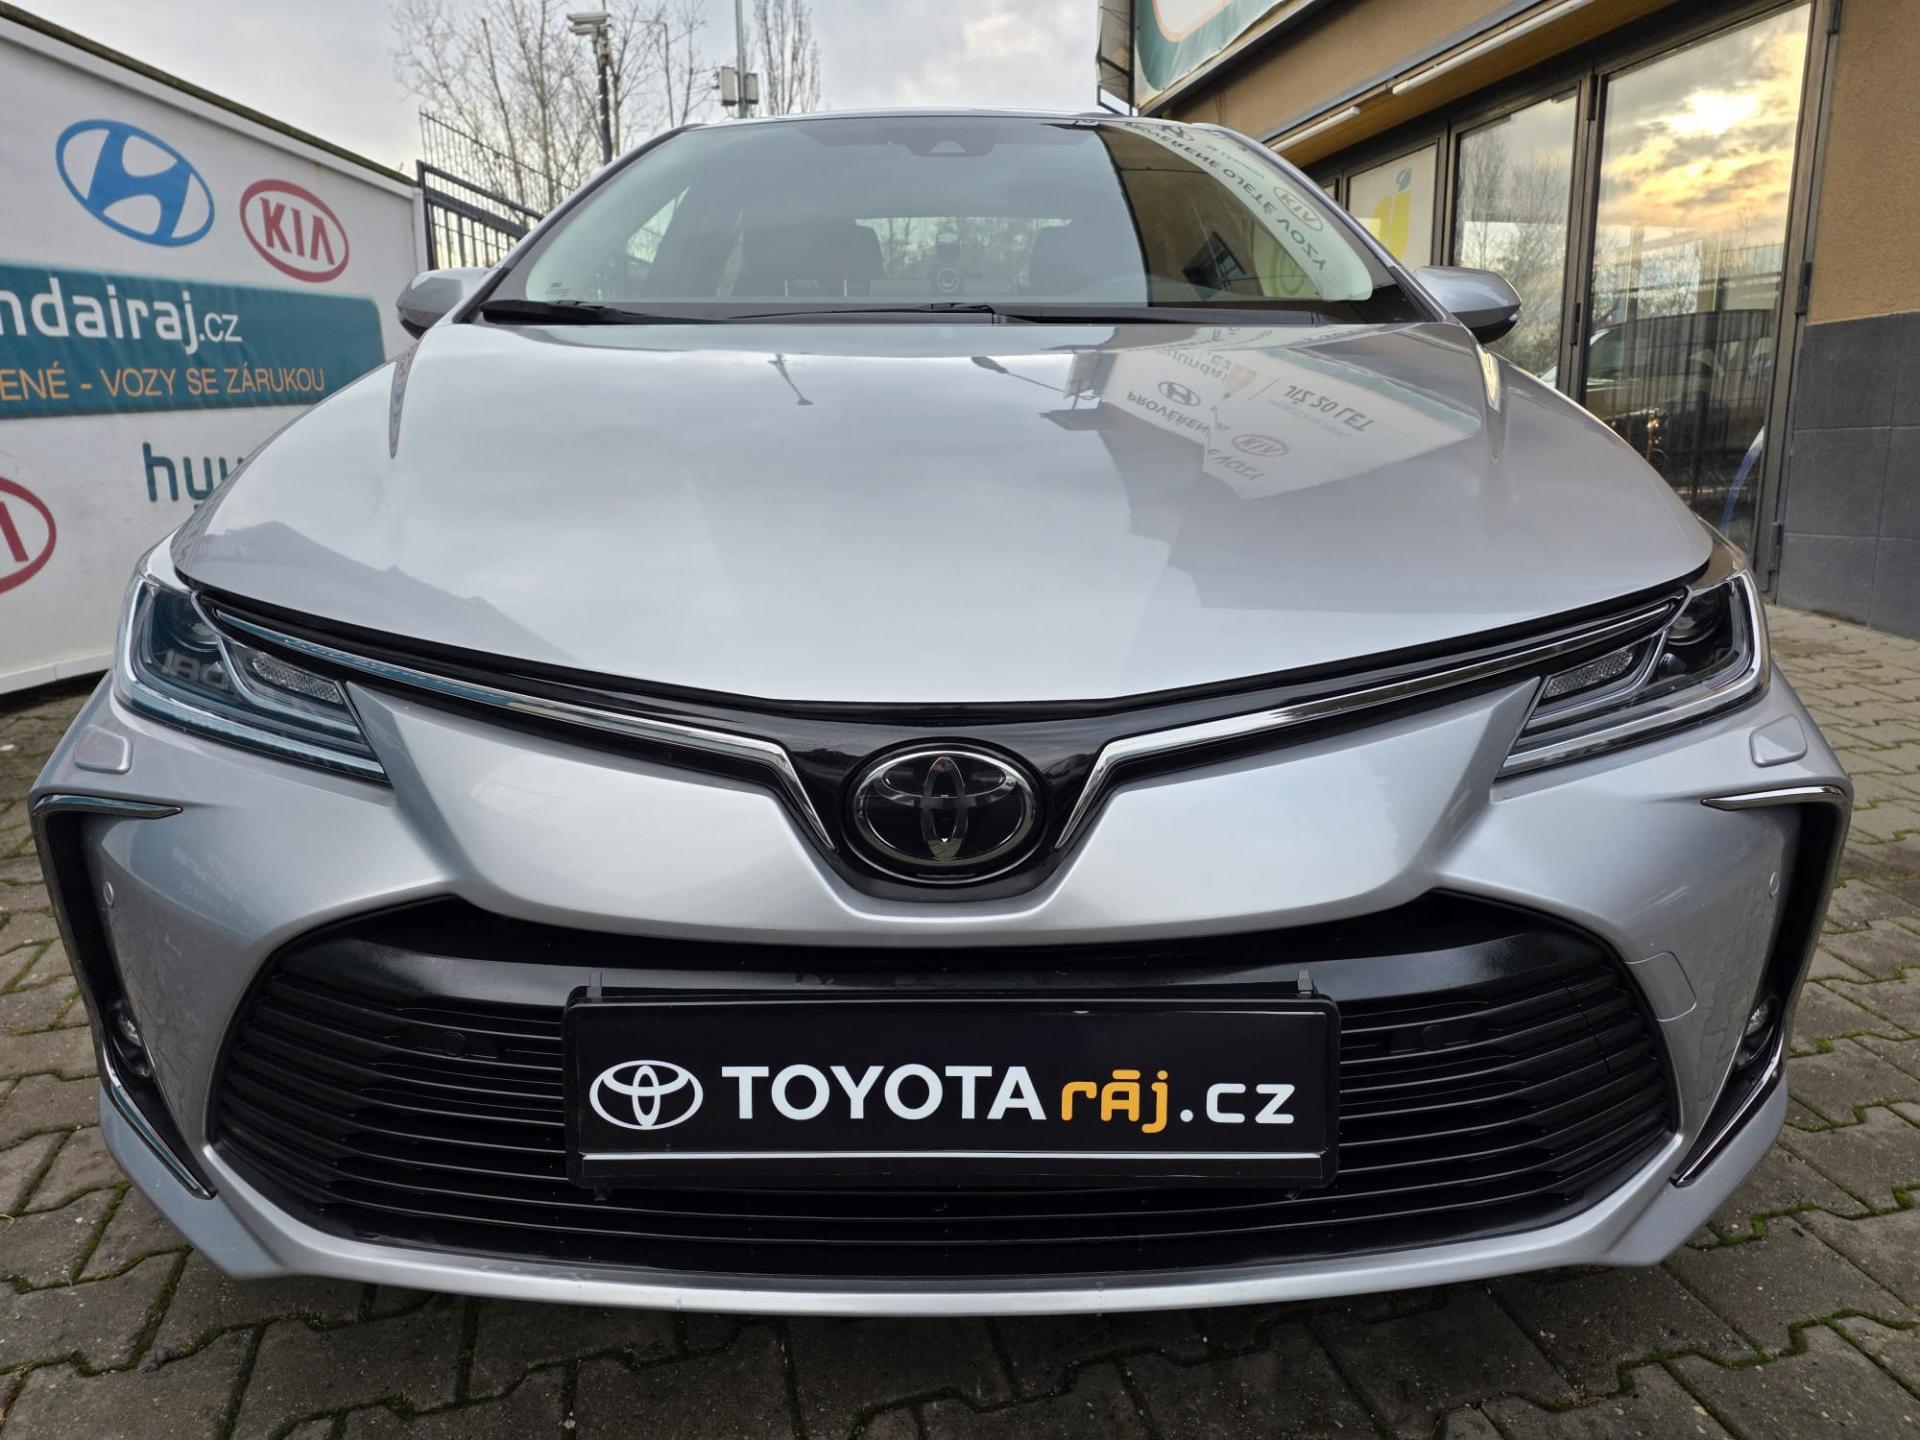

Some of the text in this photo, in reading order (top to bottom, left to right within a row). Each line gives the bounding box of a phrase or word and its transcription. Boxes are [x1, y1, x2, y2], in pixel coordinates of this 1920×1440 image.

[260, 197, 336, 267] KIA
[100, 367, 176, 397] VOZY
[187, 368, 219, 394] SE
[224, 362, 325, 393] ZÁRUKOU
[722, 1063, 1047, 1120] TOYOTA
